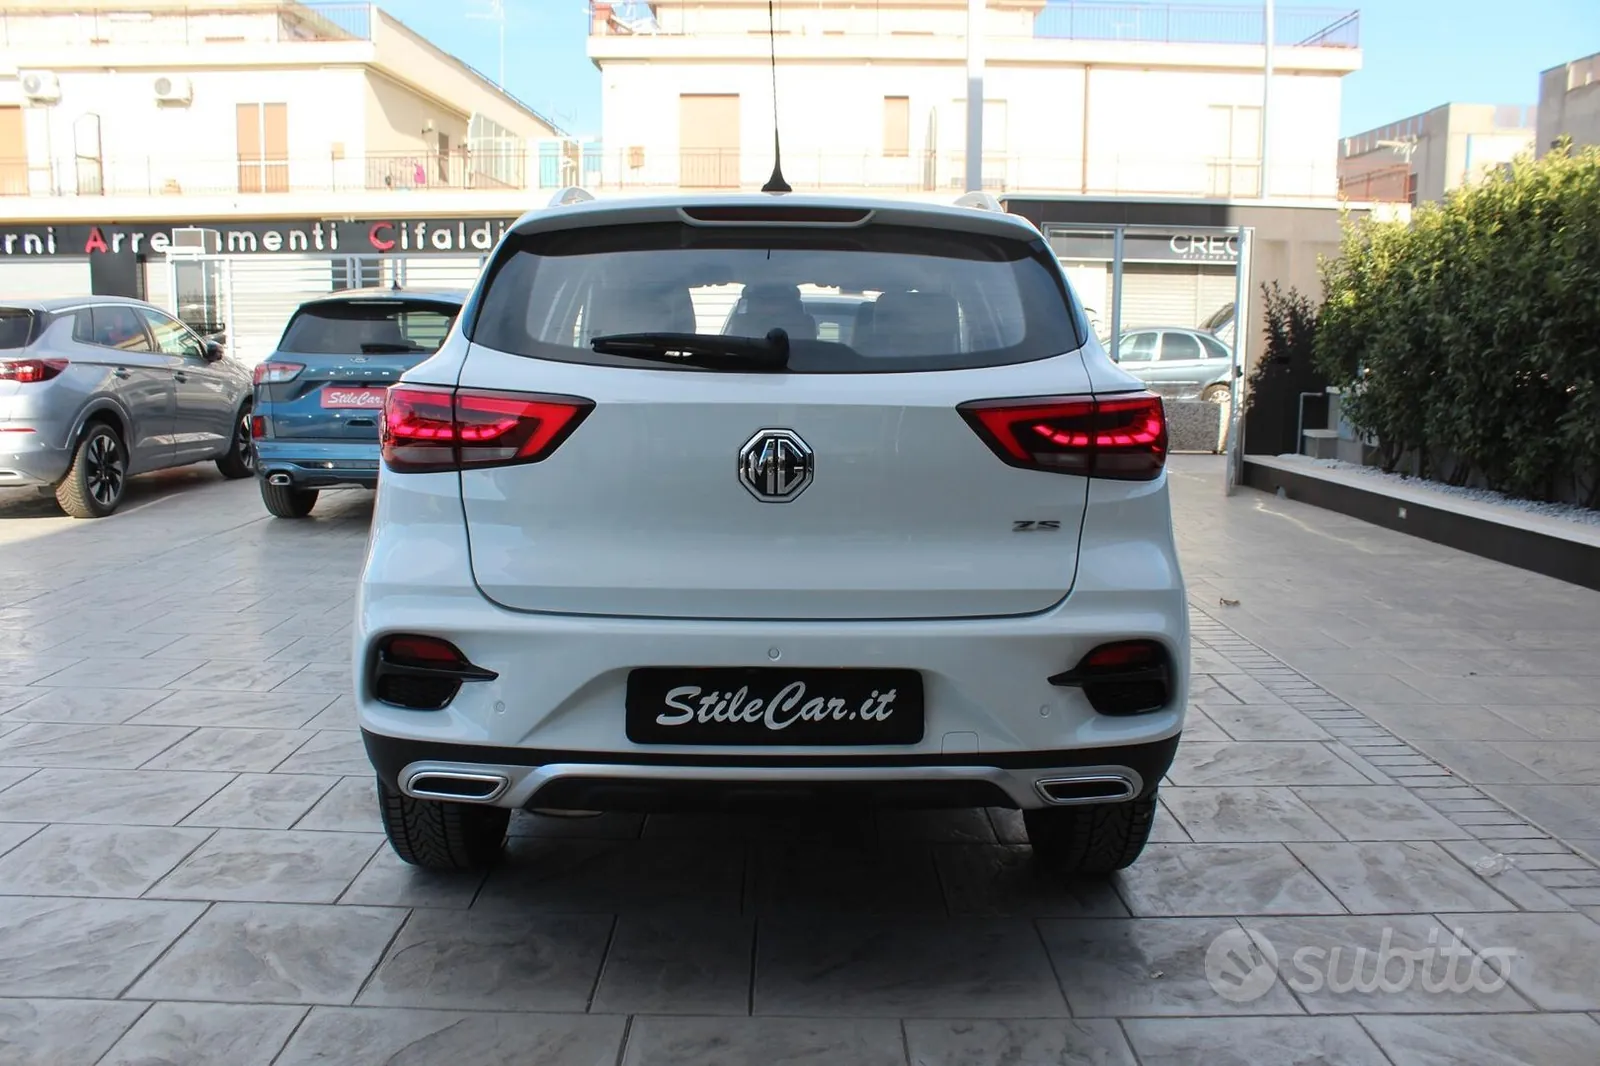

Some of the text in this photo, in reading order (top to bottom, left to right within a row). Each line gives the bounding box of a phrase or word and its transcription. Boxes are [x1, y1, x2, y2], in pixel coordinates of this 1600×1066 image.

[0, 220, 505, 254] rni Arrementi Cifaldi
[748, 438, 804, 495] MG
[1011, 520, 1061, 532] ZS
[655, 681, 897, 730] StileCar.it
